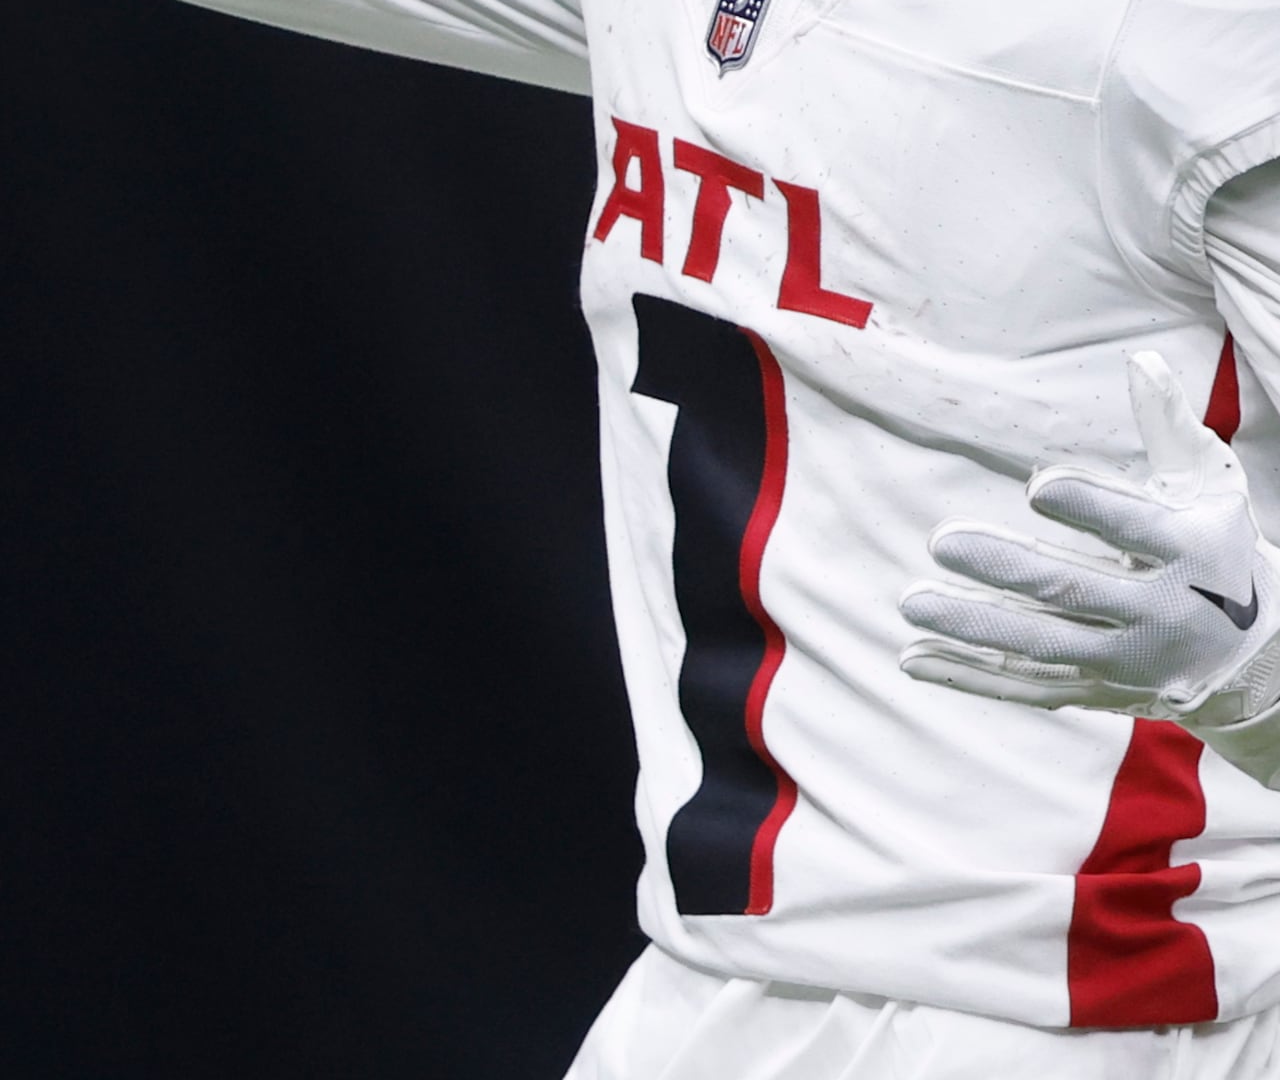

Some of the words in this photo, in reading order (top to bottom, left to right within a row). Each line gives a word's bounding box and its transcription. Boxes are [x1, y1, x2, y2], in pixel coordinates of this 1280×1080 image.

[711, 15, 747, 57] NFL
[593, 116, 874, 330] ATL
[630, 292, 798, 915] 1
